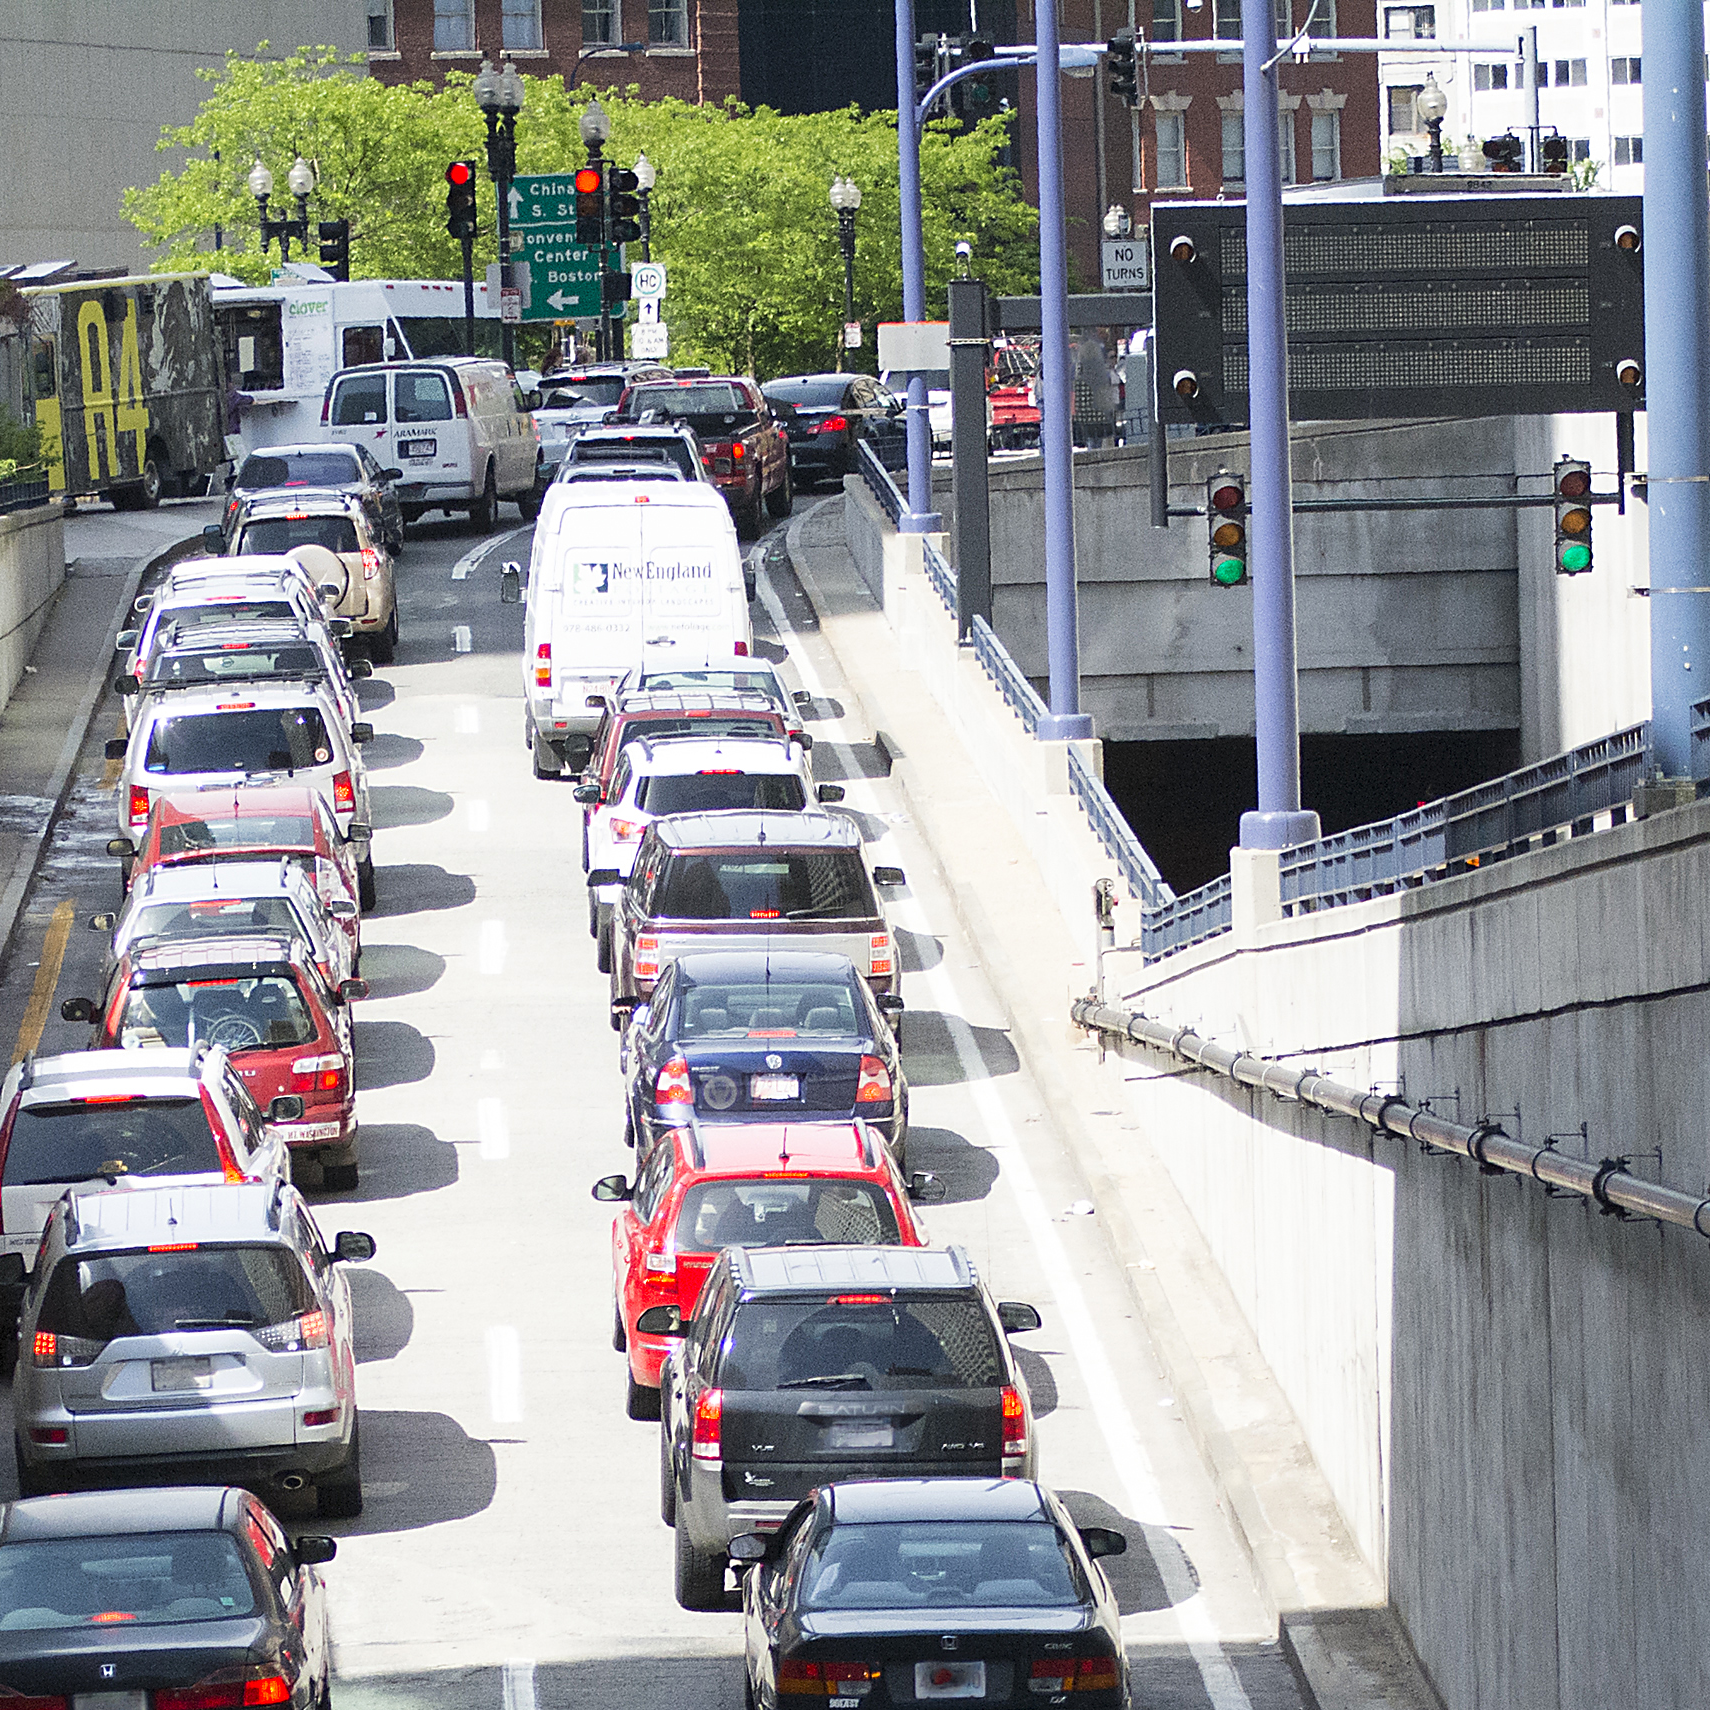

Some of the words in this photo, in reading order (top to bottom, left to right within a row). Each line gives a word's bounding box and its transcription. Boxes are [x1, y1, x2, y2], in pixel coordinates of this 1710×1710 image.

[530, 182, 576, 196] China
[532, 205, 547, 217] S.
[526, 233, 577, 245] onven
[534, 250, 589, 262] Center
[1115, 248, 1133, 261] NO
[1106, 267, 1144, 280] TURNS
[640, 274, 657, 288] HC
[289, 300, 328, 315] clover
[393, 428, 438, 439] ARAMARK
[818, 1404, 905, 1415] SATURN
[751, 1444, 775, 1452] VUE
[1044, 1642, 1073, 1650] CIVIC
